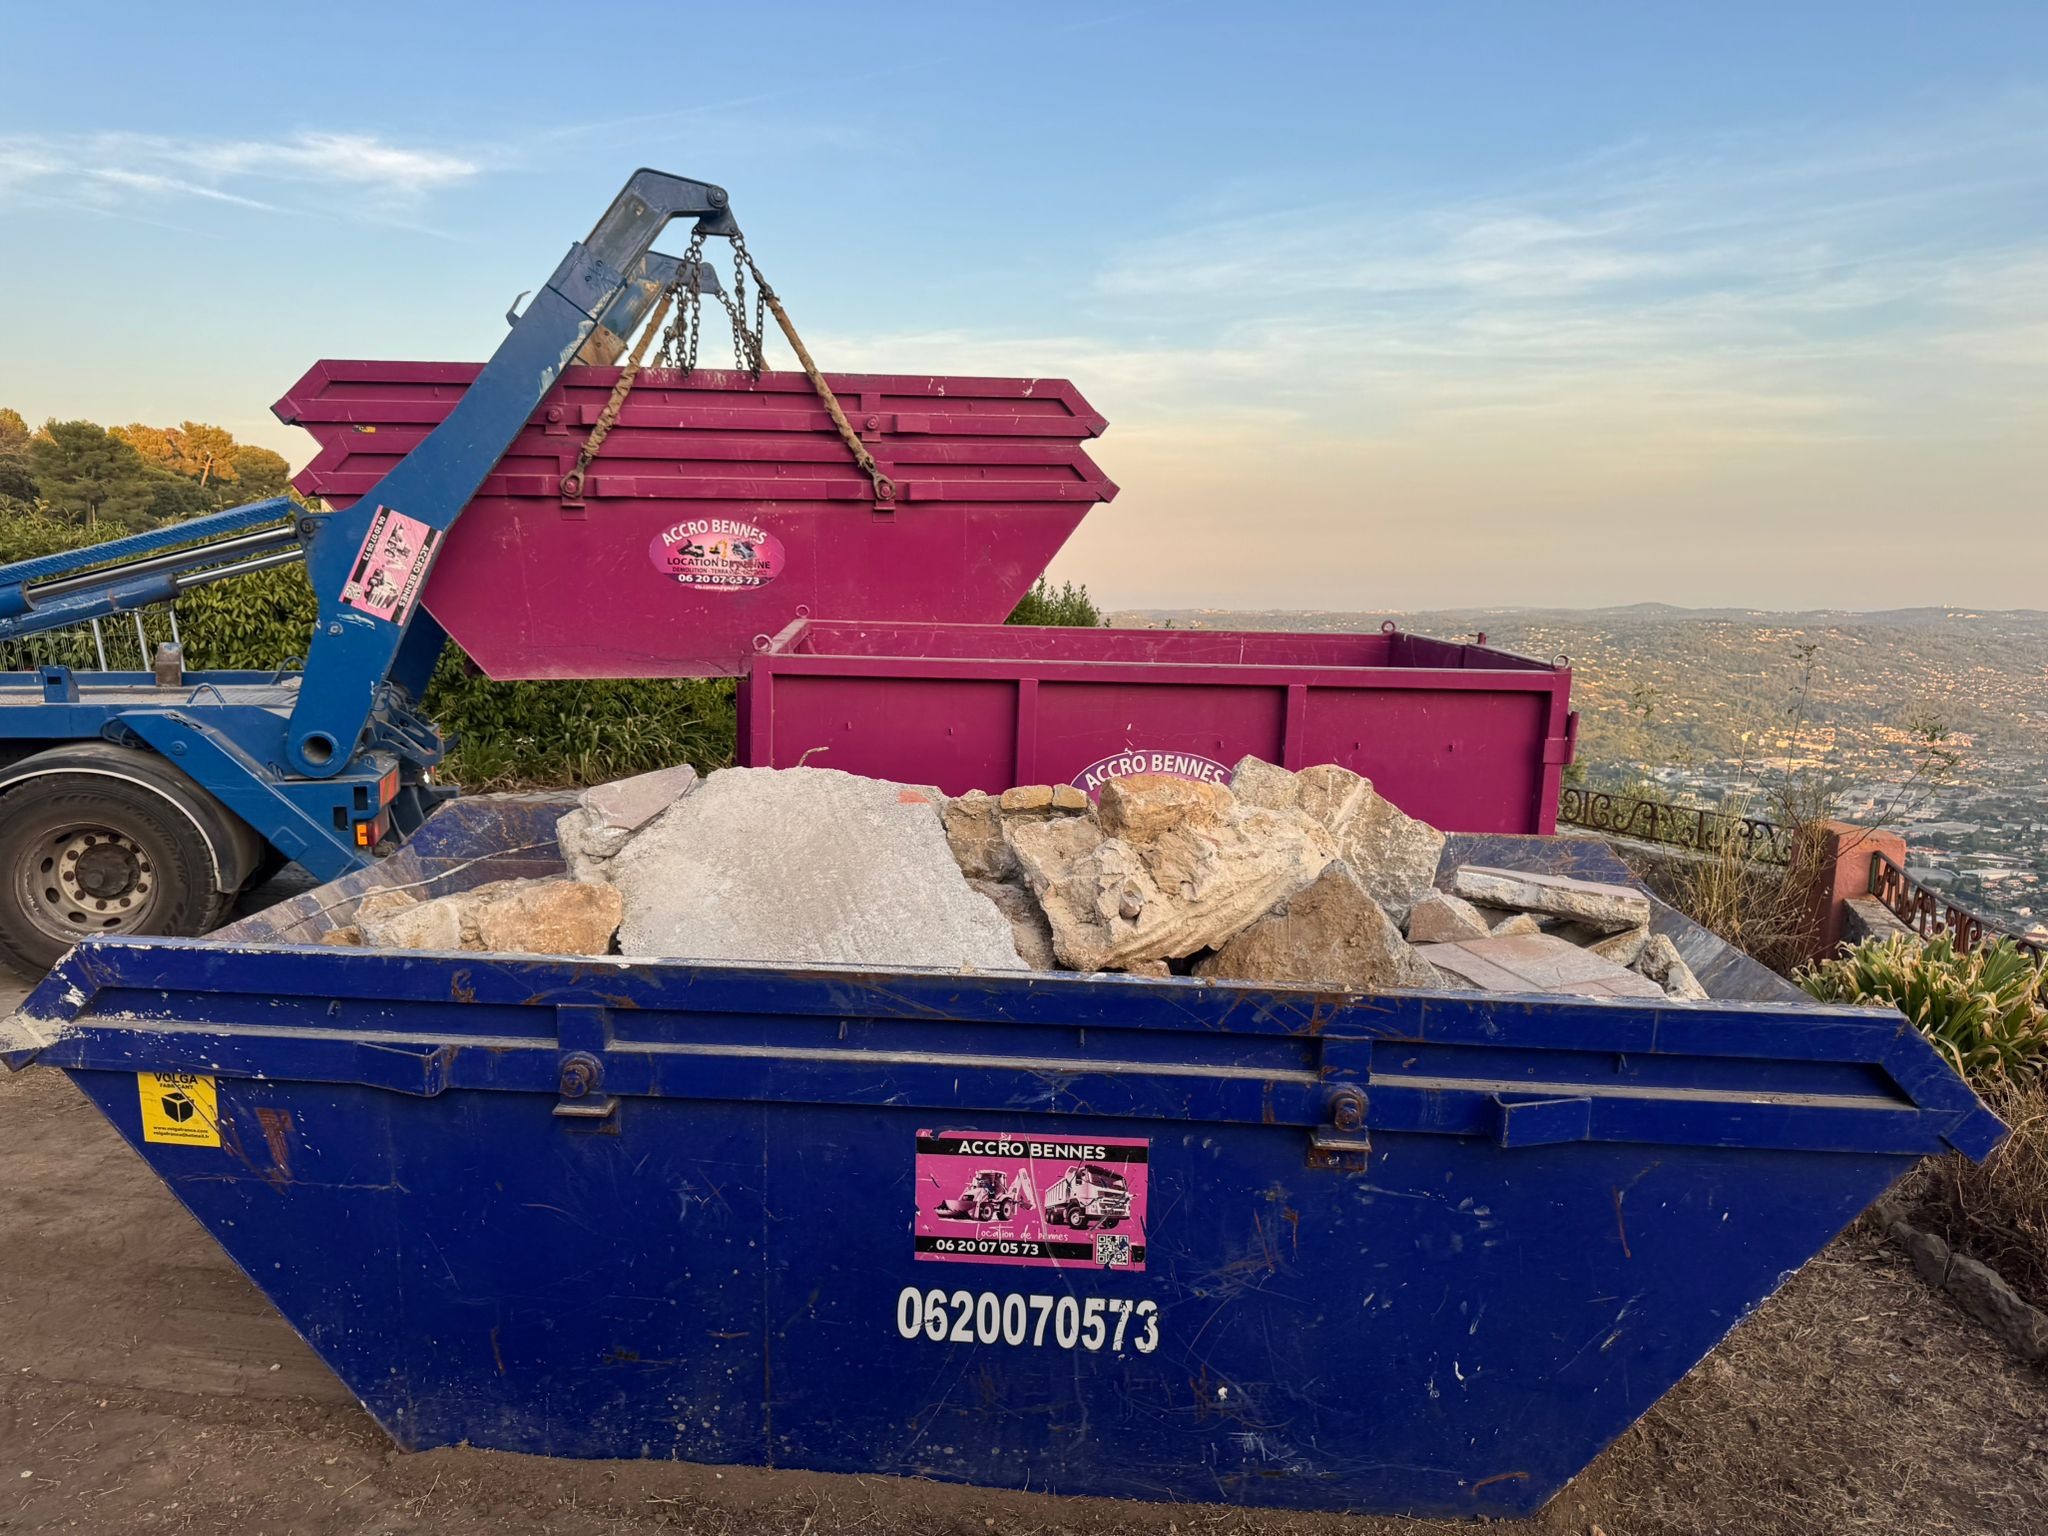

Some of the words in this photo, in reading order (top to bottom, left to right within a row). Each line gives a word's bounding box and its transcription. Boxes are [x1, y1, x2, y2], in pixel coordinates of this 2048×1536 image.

[374, 525, 382, 534] 20
[377, 516, 386, 525] 06
[661, 519, 708, 546] ACCRO
[711, 519, 767, 545] BENNES
[412, 545, 430, 573] ACCRO
[667, 557, 719, 567] LOCATION
[678, 574, 693, 583] 06
[695, 575, 710, 584] 20
[712, 575, 726, 584] 07
[746, 576, 760, 585] 73
[398, 575, 418, 607] BENNES
[1085, 755, 1146, 791] ACCRO
[1151, 754, 1225, 785] BENNES
[153, 1072, 199, 1085] VOLGA
[958, 1140, 1024, 1156] ACCRO
[1030, 1143, 1106, 1160] BENNES
[1020, 1224, 1032, 1243] de
[936, 1239, 955, 1251] 06
[958, 1240, 977, 1252] 20
[979, 1241, 998, 1253] 07
[1000, 1243, 1018, 1255] 05
[1021, 1244, 1039, 1256] 73
[897, 1286, 1159, 1354] 0620070573
